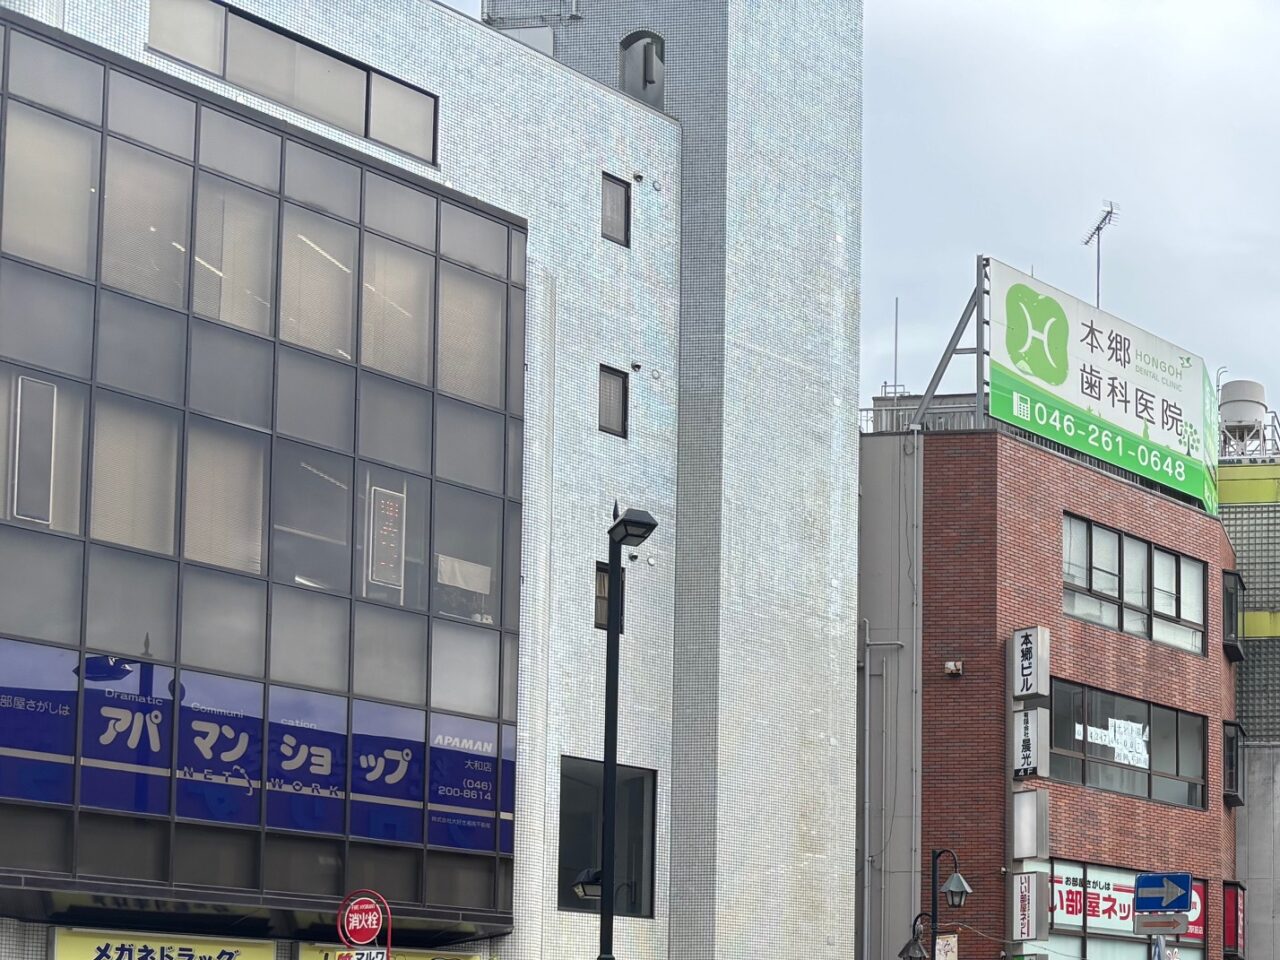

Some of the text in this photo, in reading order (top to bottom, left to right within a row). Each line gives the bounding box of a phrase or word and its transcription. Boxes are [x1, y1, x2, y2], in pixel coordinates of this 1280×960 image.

[1080, 319, 1132, 369] 本郷
[1135, 349, 1183, 381] HONGOH
[1135, 365, 1183, 393] DENTAL CLINIC
[1080, 363, 1184, 432] 歯科医院
[1035, 402, 1187, 482] 046-261-0648
[1020, 632, 1033, 692] 本郷ビル
[105, 688, 163, 706] Dramatic
[433, 734, 493, 753] APAMAN
[464, 760, 492, 772] 大和店
[438, 785, 491, 800] 200-8614
[463, 778, 492, 791] (046)
[1064, 876, 1111, 892] お部屋さがしは
[348, 911, 379, 930] 消火栓
